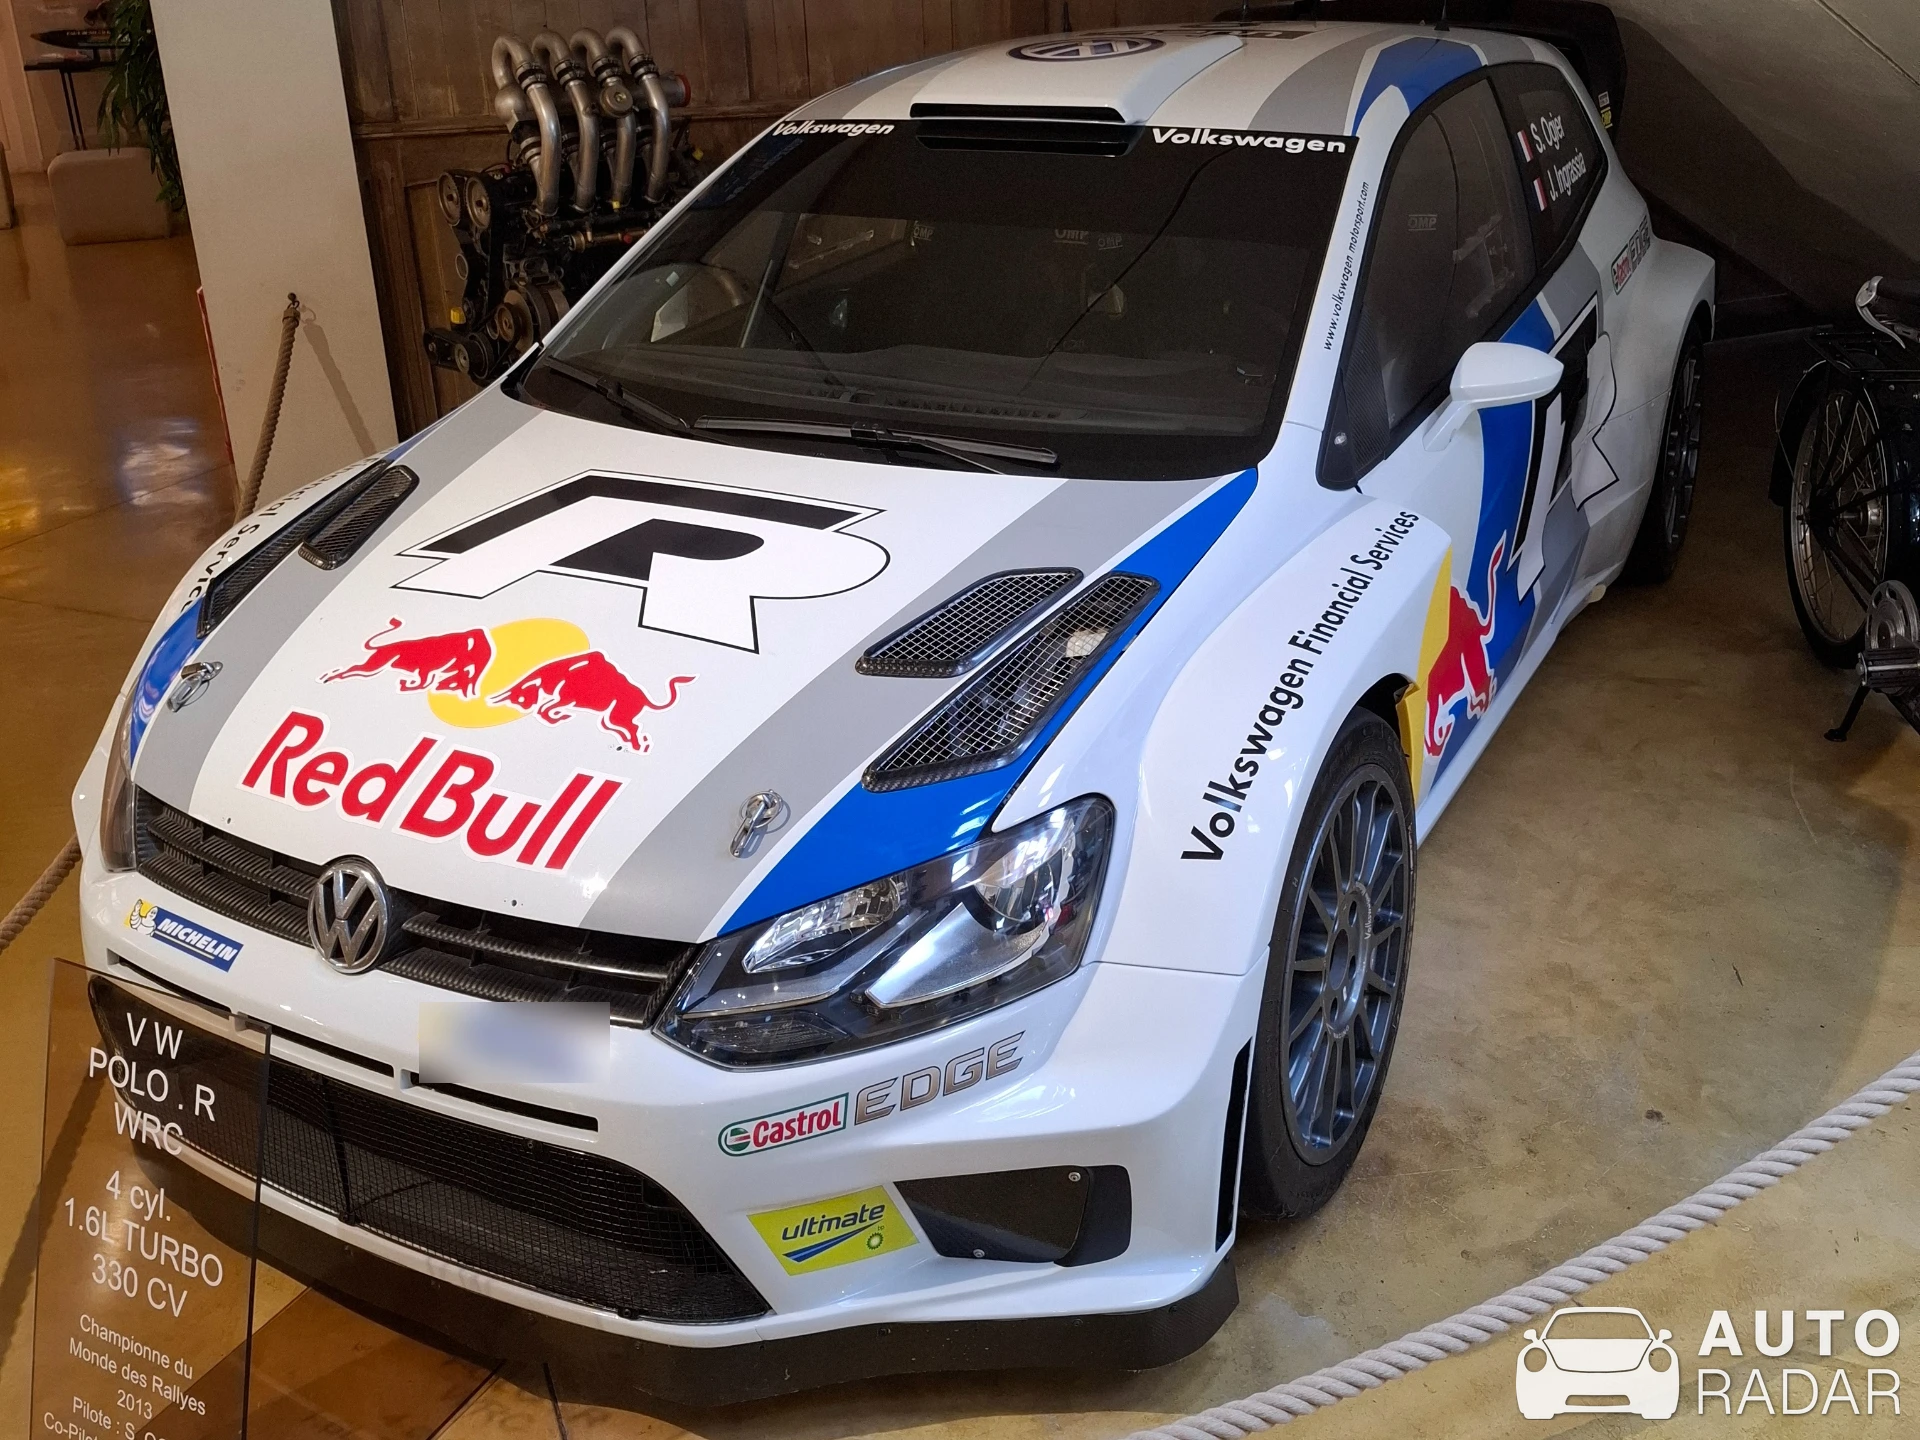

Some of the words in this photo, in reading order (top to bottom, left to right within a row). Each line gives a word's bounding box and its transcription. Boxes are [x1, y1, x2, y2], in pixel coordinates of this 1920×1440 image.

[772, 120, 895, 137] Volkswagen
[1152, 128, 1346, 153] Volkswagen
[1530, 123, 1546, 153] S.
[1540, 112, 1565, 150] Ogier
[1547, 170, 1559, 201] J.
[1553, 147, 1587, 196] Ingrassia
[1324, 255, 1354, 350] www.volkswagen
[1348, 181, 1369, 253] motorsport.com
[1180, 658, 1314, 861] Volkswagen
[1287, 567, 1375, 655] Financial
[1349, 510, 1420, 571] Services
[241, 711, 438, 827] Red
[399, 749, 623, 870] Bull
[158, 917, 239, 962] MICHELIN
[89, 1047, 170, 1102] POLO
[752, 1101, 842, 1149] Castrol
[854, 1029, 1026, 1126] EDGE
[114, 1102, 184, 1156] WRC
[106, 1171, 120, 1200] 4
[130, 1184, 171, 1222] cyl.
[781, 1202, 886, 1242] ultimate
[65, 1197, 115, 1244] 1.6L
[122, 1220, 224, 1288] TURBO
[92, 1254, 139, 1298] 330
[147, 1277, 188, 1318] CV
[80, 1314, 170, 1367] Championne
[174, 1357, 193, 1379] du
[69, 1337, 117, 1374] Monde
[121, 1362, 149, 1388] des
[152, 1375, 206, 1416] Rallyes
[43, 1412, 98, 1440] Co-Pil
[72, 1396, 112, 1430] Pilote
[116, 1389, 153, 1420] 2013
